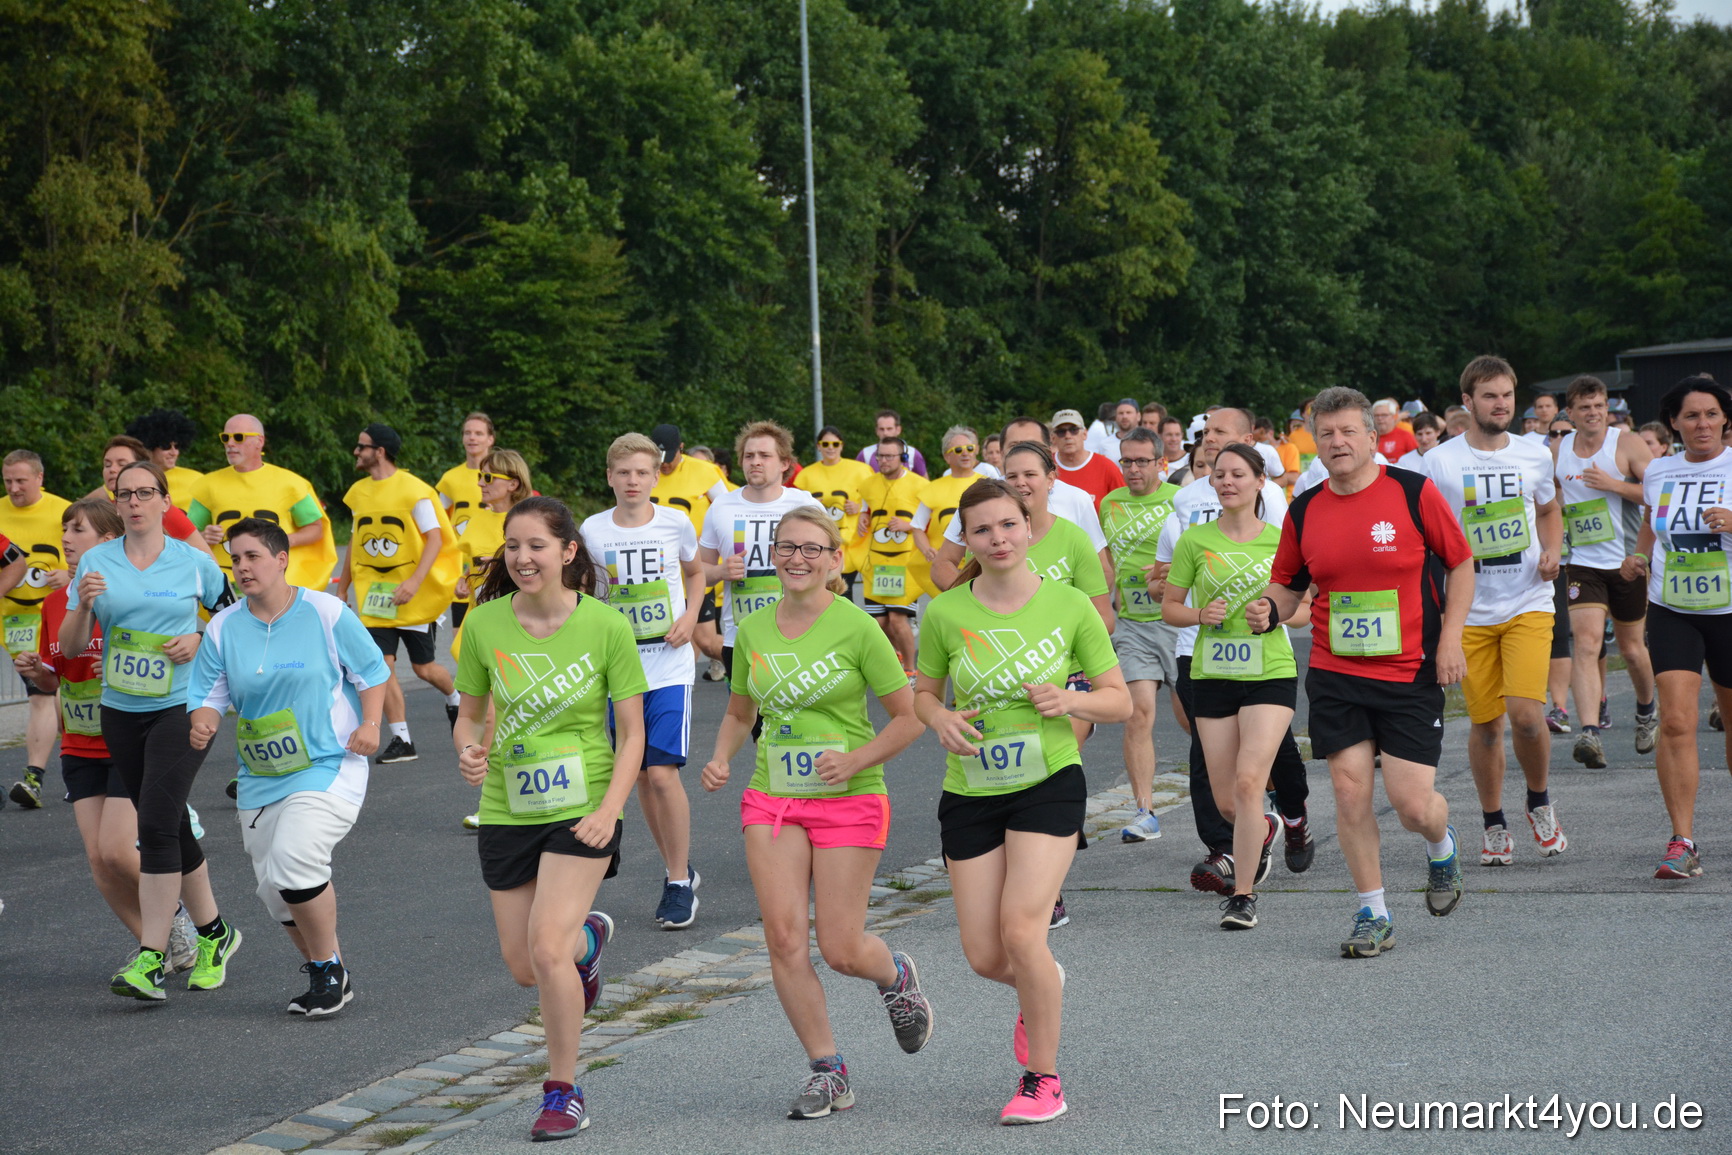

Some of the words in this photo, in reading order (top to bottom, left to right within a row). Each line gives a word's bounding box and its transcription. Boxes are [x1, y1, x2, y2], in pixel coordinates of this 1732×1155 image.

[1478, 473, 1517, 498] TE
[1678, 481, 1719, 505] TE
[1473, 519, 1524, 544] 1162
[1575, 517, 1602, 534] 546
[1372, 544, 1397, 552] caritas
[619, 548, 658, 576] TE
[876, 577, 902, 588] 1014
[1670, 575, 1721, 594] 1161
[368, 595, 393, 608] 1017
[8, 629, 33, 642] 1023
[1341, 617, 1382, 638] 251
[1212, 643, 1251, 662] 200
[113, 653, 166, 680] 1503
[279, 661, 305, 669] sumida
[243, 736, 298, 761] 1500
[974, 741, 1026, 771] 197
[516, 764, 571, 796] 204
